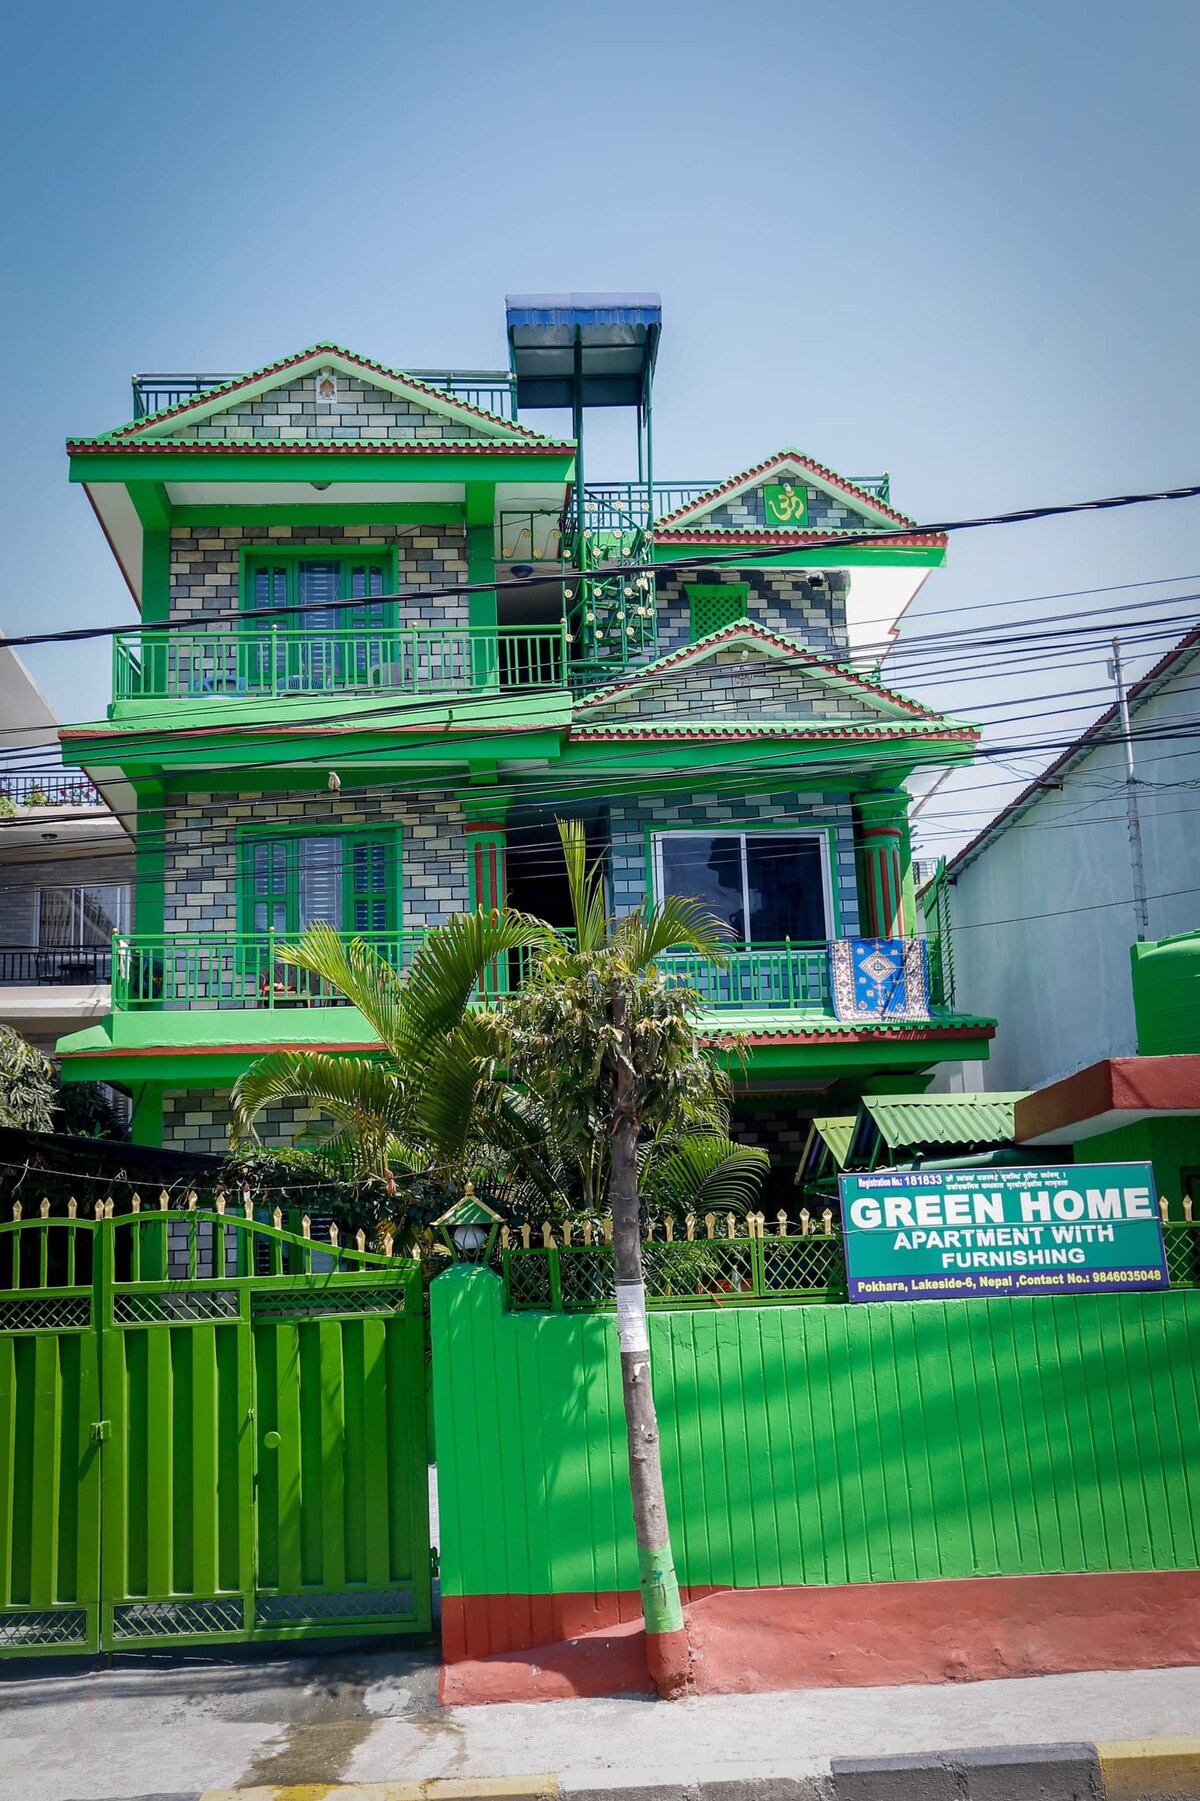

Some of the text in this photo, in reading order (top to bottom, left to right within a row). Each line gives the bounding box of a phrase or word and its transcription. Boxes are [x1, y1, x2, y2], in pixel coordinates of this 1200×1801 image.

[858, 1177, 891, 1190] Registration
[905, 1175, 942, 1186] 181833
[850, 1187, 1152, 1229] GREEN HOME
[893, 1224, 1115, 1250] APARTMENT WITH
[942, 1247, 1086, 1268] FURNISHING
[857, 1281, 908, 1293] Pokhara,
[911, 1276, 976, 1290] Lakeside-6,
[979, 1275, 1012, 1289] Nepal
[1067, 1273, 1090, 1284] No.:
[1092, 1269, 1161, 1283] 9846035048
